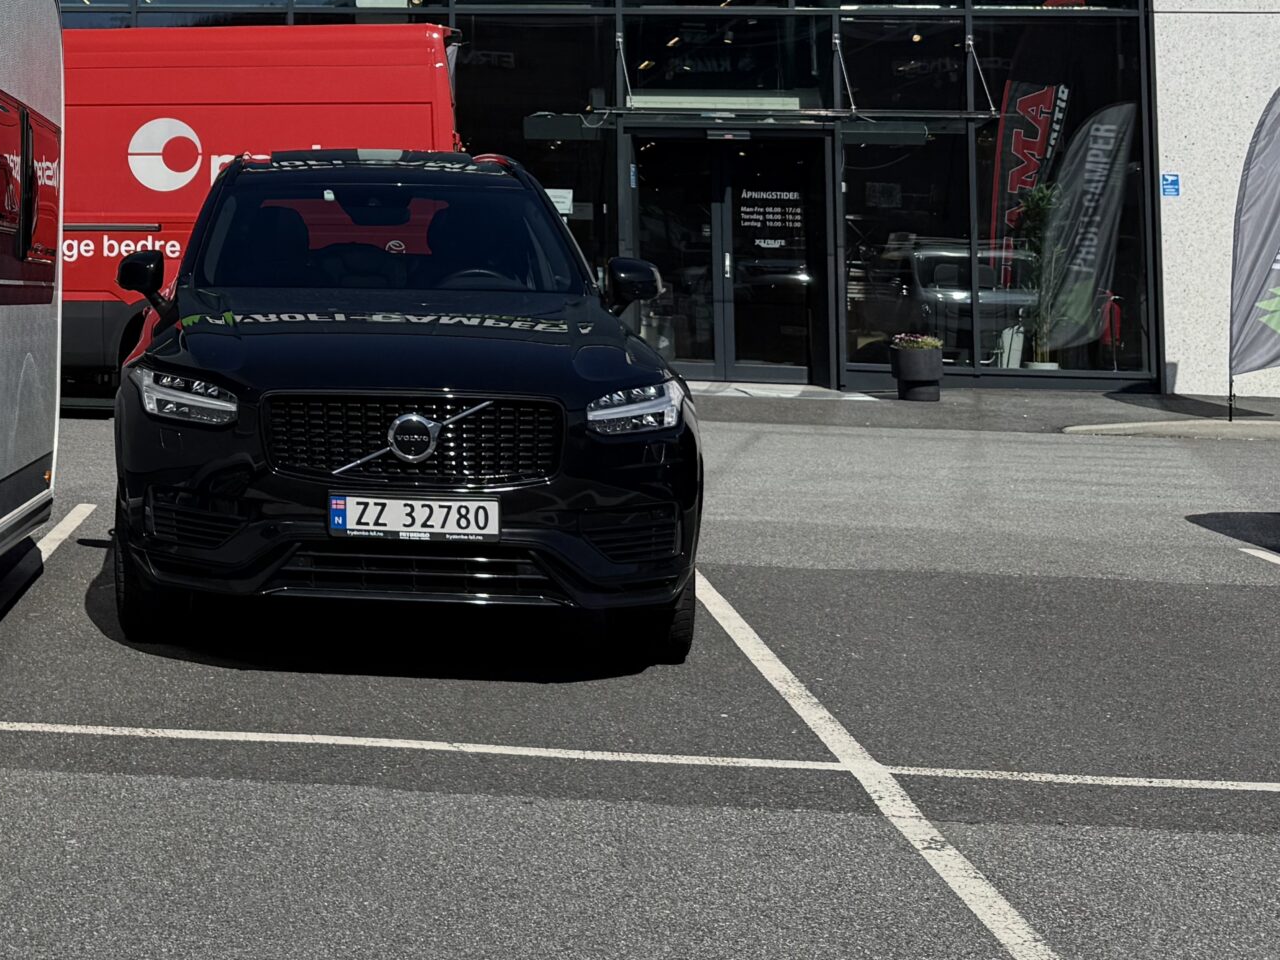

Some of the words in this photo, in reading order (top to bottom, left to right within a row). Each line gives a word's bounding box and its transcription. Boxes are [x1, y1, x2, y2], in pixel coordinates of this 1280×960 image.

[103, 235, 181, 257] bedre
[334, 516, 343, 525] N
[355, 501, 388, 527] ZZ
[402, 503, 490, 531] 32780
